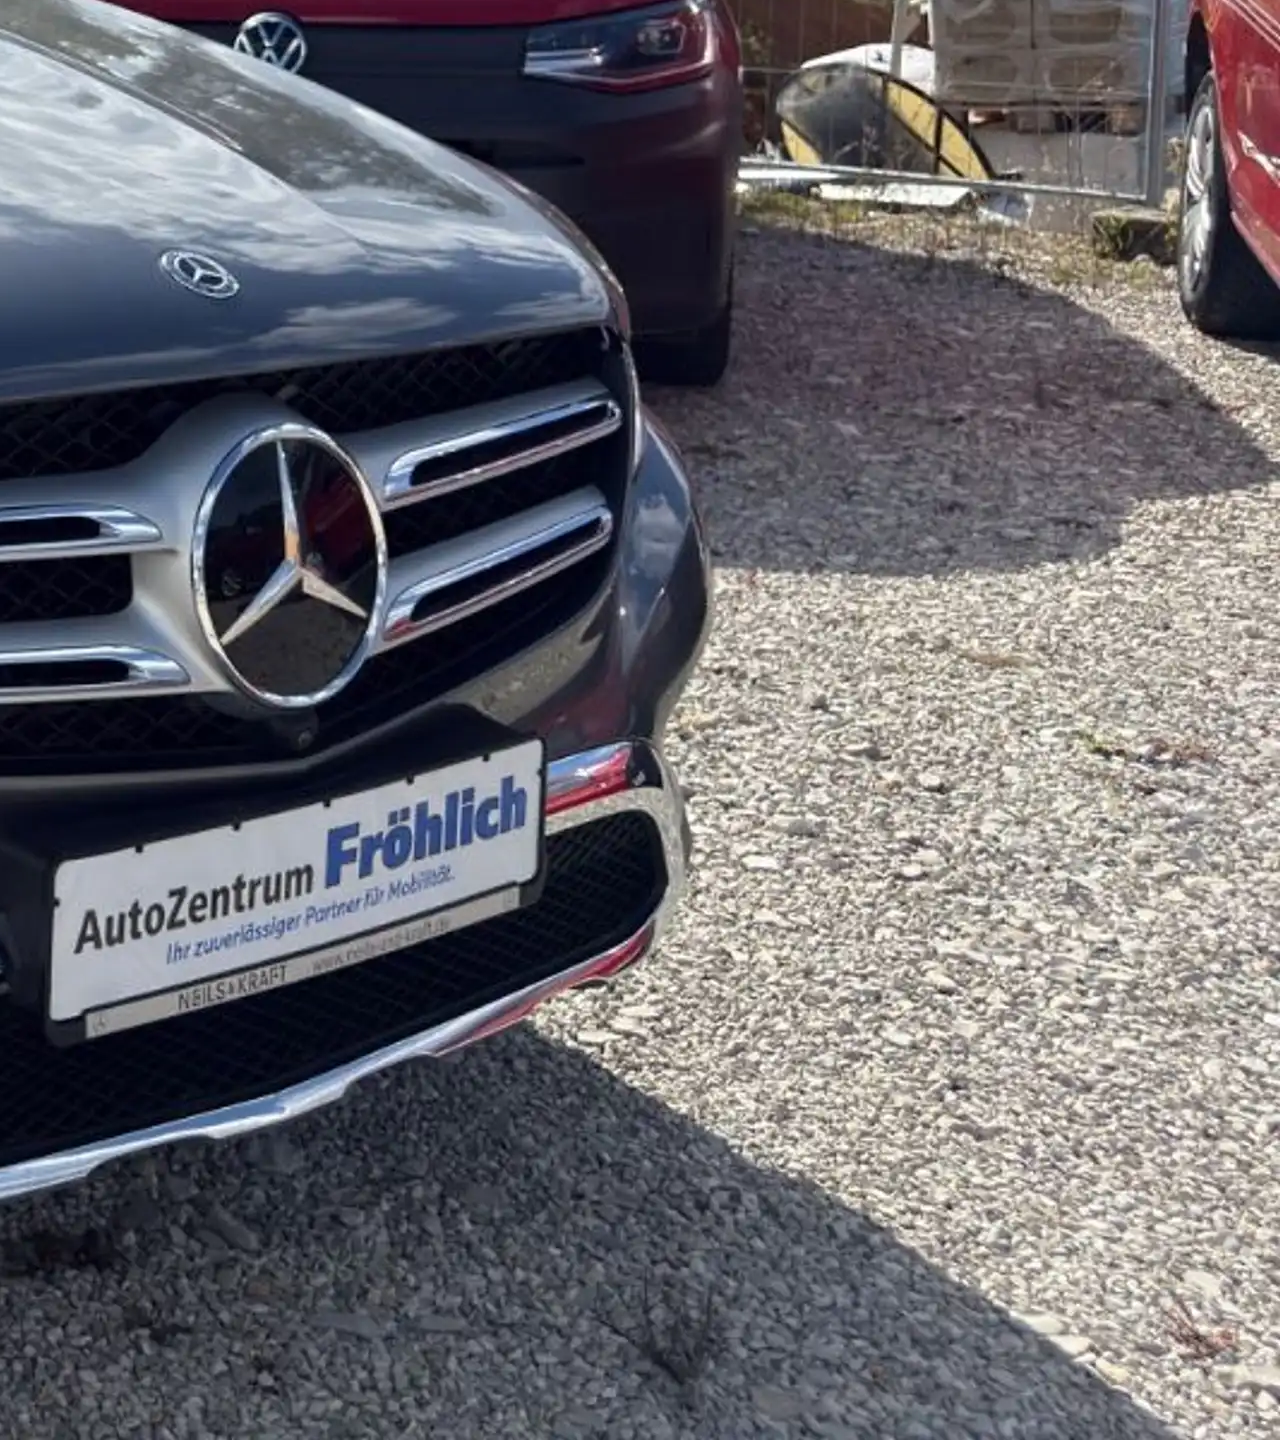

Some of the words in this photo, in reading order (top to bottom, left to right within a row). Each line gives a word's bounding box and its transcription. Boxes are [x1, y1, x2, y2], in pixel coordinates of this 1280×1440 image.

[73, 863, 314, 954] AutoZentrum
[324, 775, 528, 889] Fröhlich
[166, 940, 192, 965] Ihr
[193, 914, 302, 958] zuverlässiger
[304, 898, 361, 927] Partner
[362, 885, 385, 910] für
